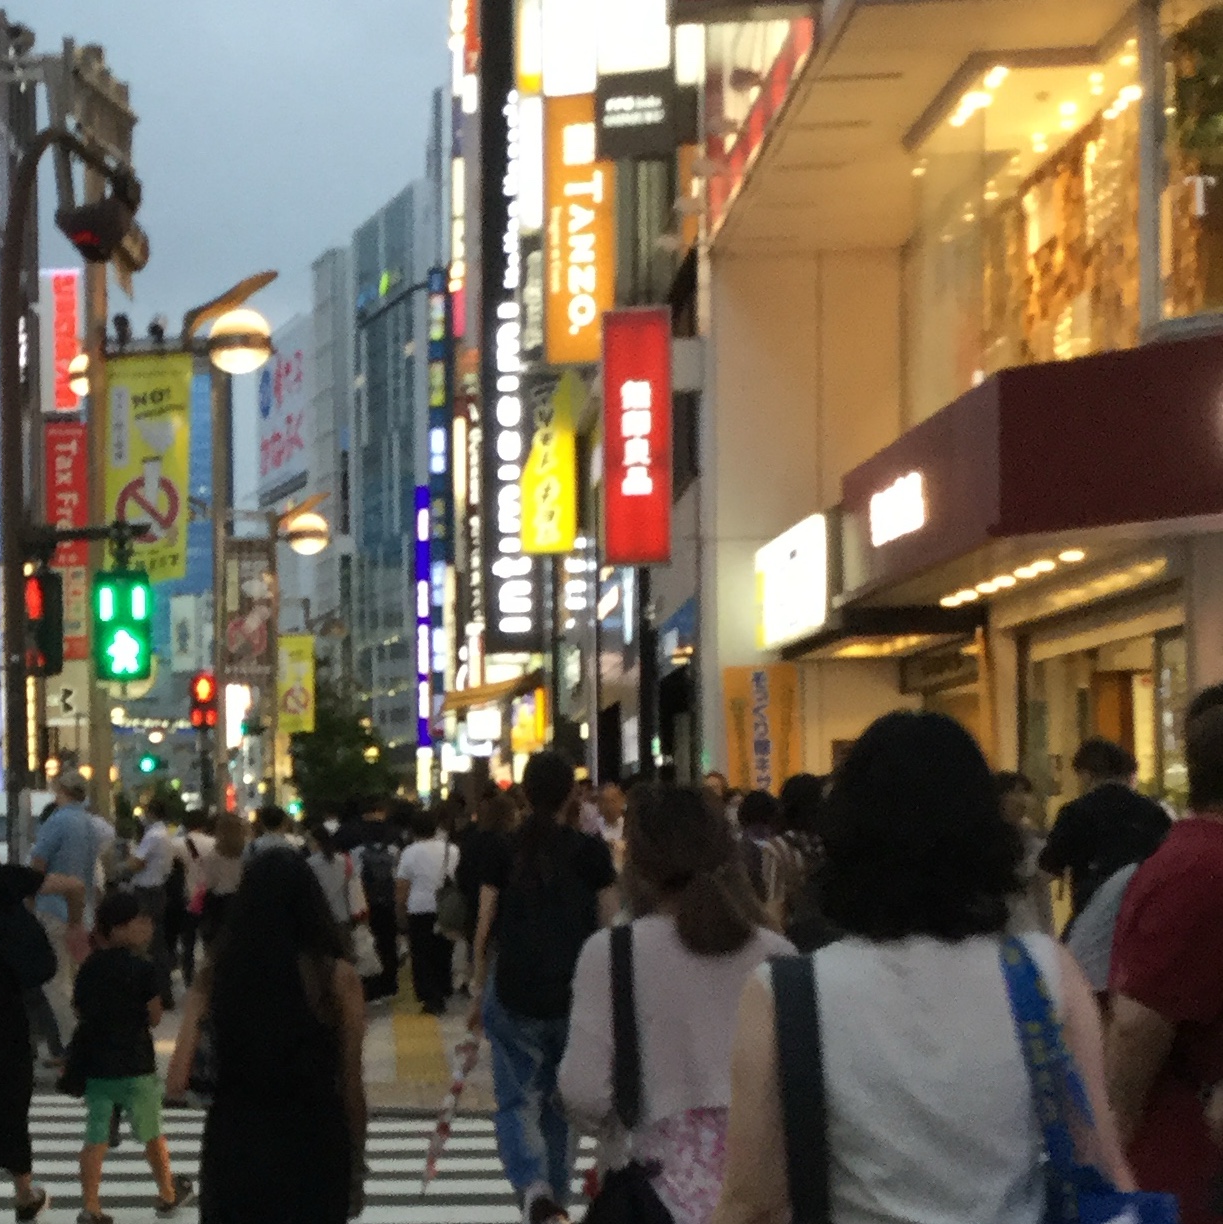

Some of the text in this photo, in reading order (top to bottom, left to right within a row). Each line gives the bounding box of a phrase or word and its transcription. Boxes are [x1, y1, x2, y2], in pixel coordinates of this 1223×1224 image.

[55, 438, 78, 487] Tax
[532, 379, 563, 546] マツモトキ
